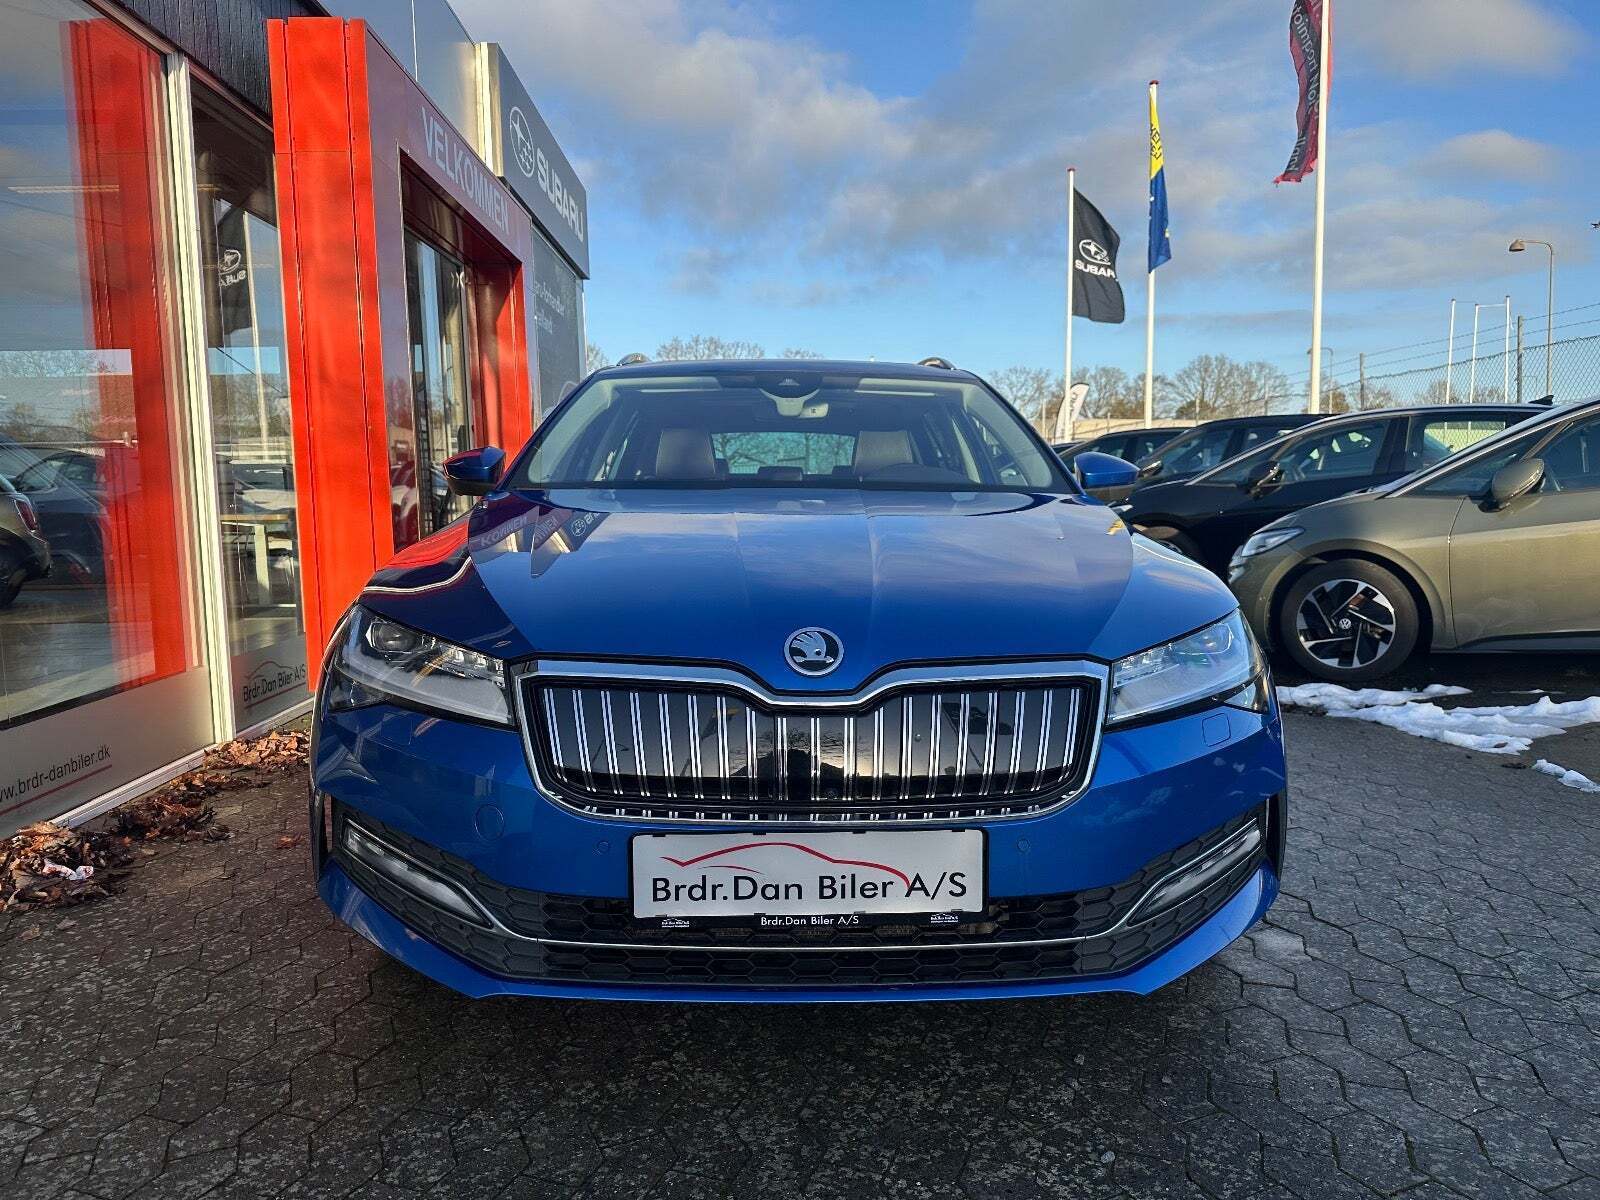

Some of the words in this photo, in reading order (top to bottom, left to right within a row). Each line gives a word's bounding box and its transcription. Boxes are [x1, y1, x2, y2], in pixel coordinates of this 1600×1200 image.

[421, 105, 510, 235] VELKOMMEN
[536, 147, 584, 243] SUBARU
[1074, 259, 1119, 282] SUBAR
[652, 874, 803, 902] Brdr.Dan
[818, 873, 894, 900] Biler
[904, 871, 967, 900] A/S
[810, 915, 835, 925] Biler
[837, 915, 860, 926] A/S
